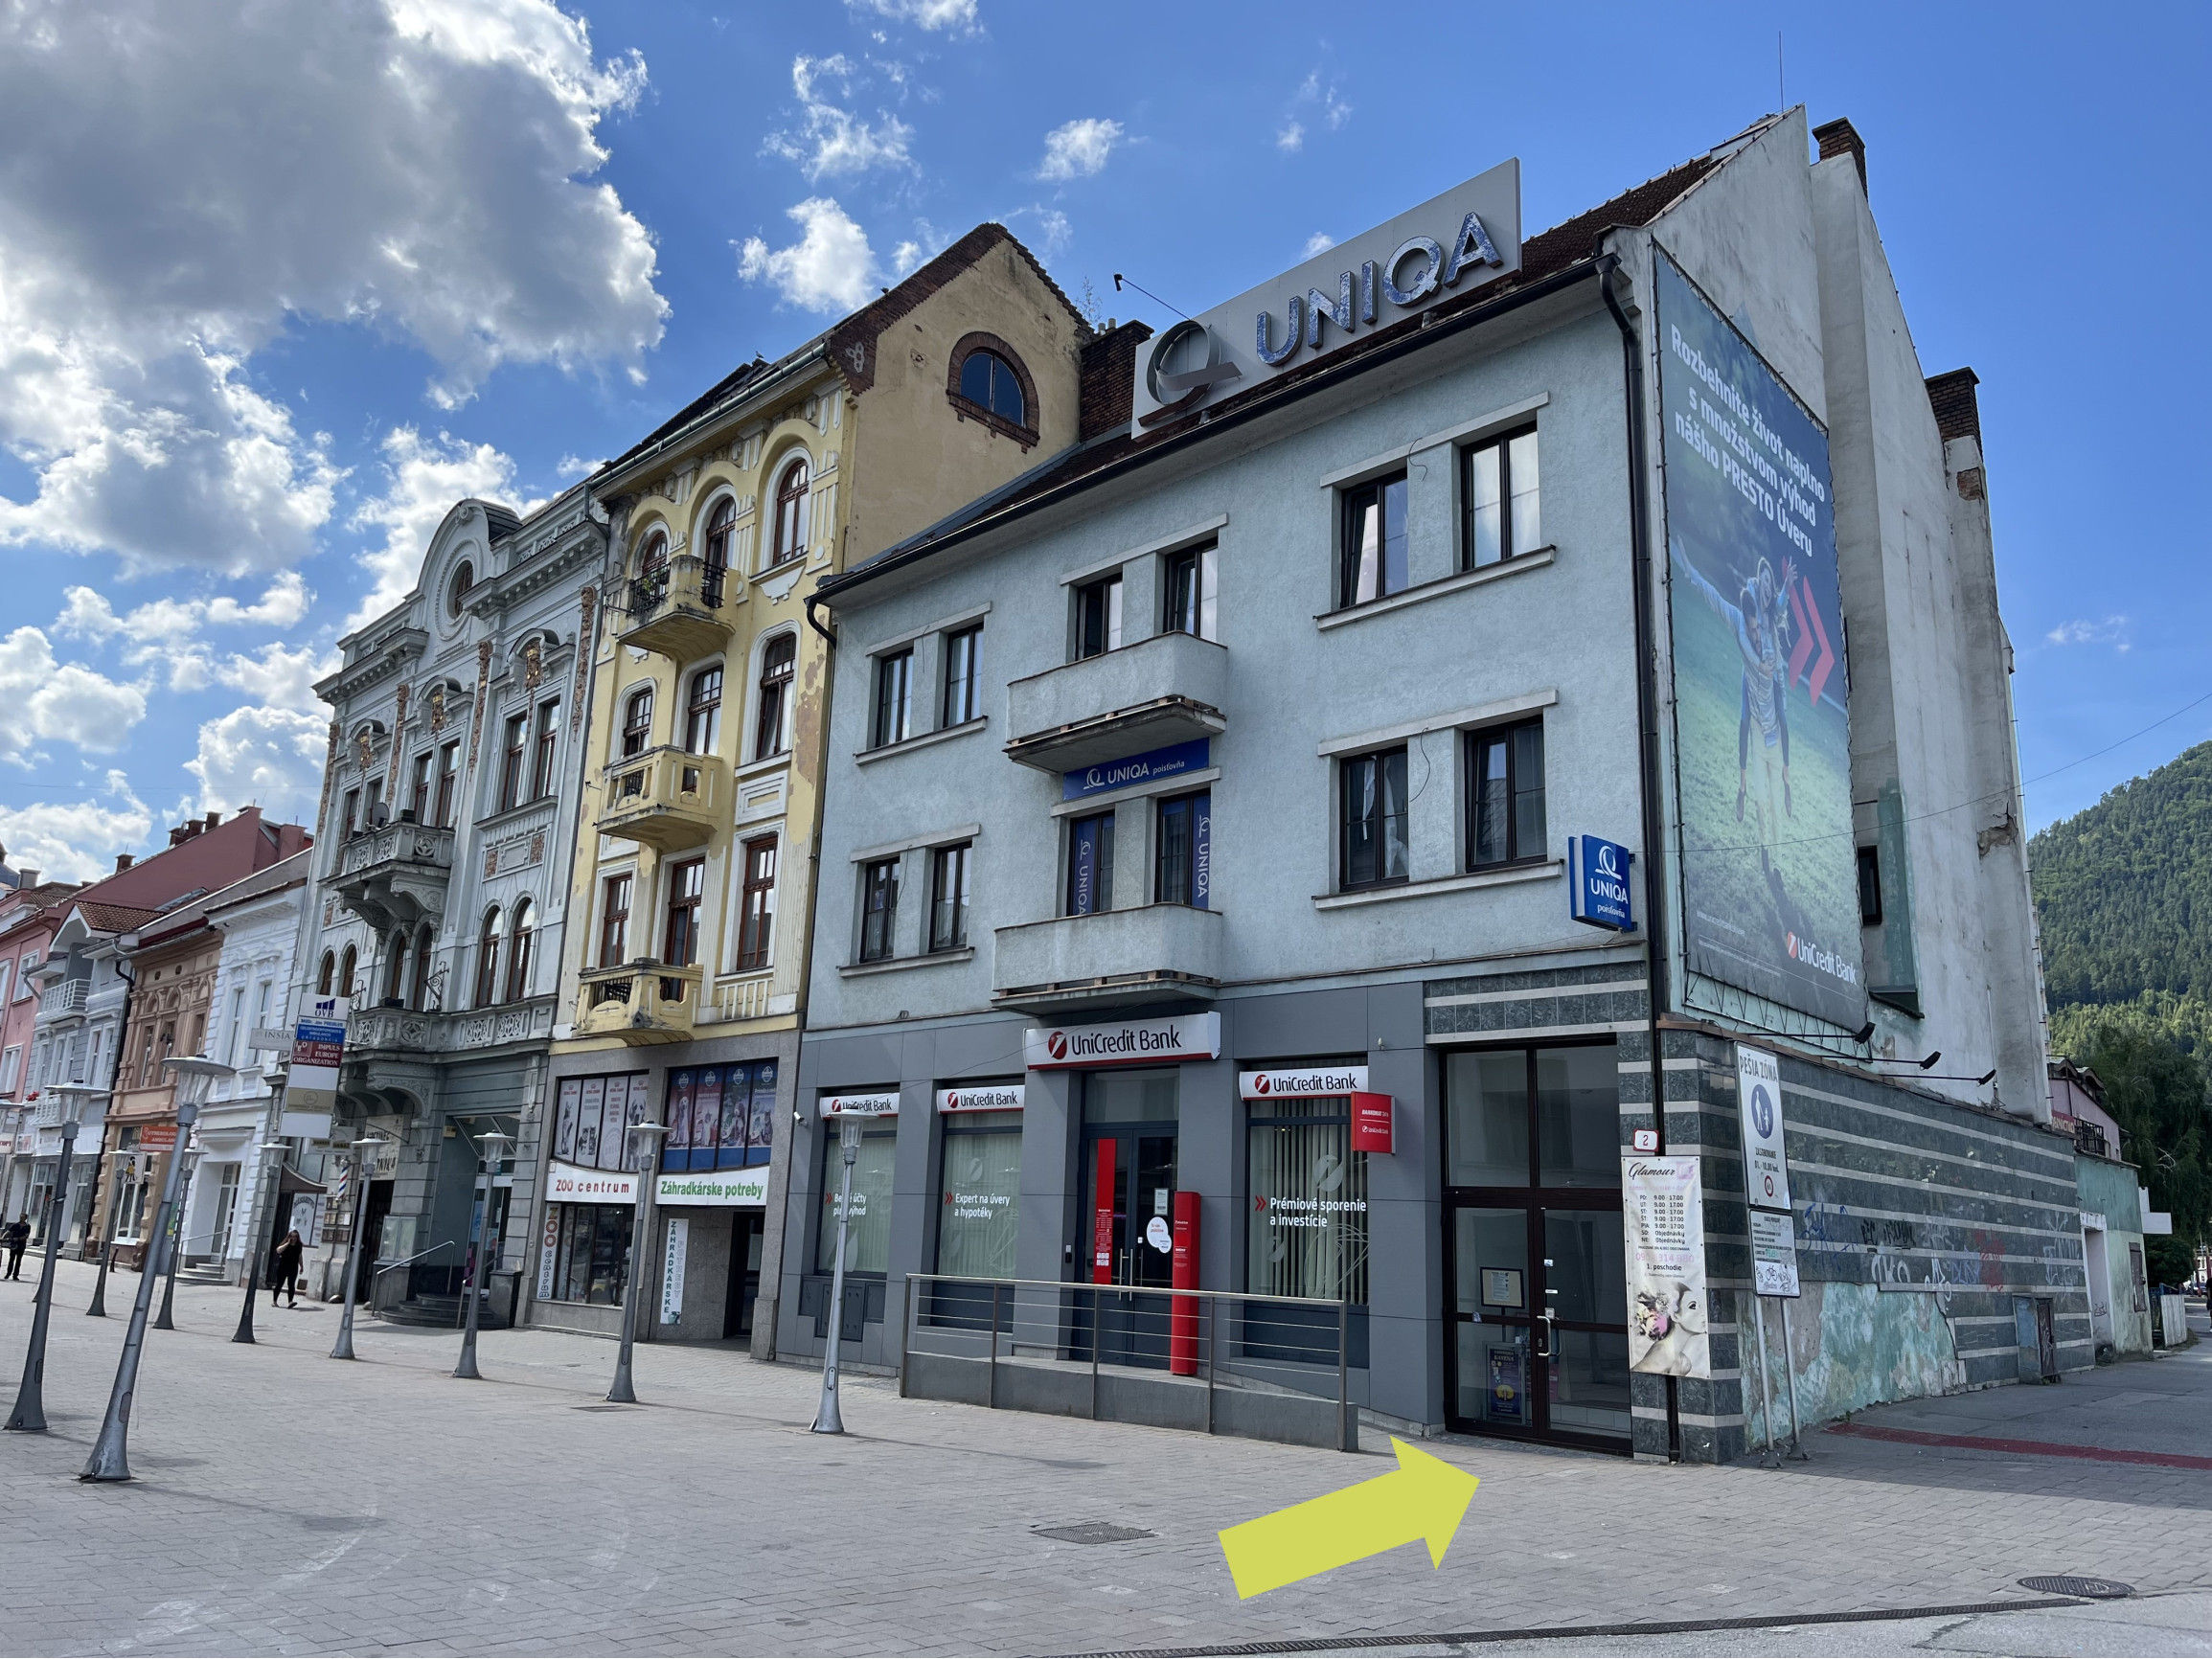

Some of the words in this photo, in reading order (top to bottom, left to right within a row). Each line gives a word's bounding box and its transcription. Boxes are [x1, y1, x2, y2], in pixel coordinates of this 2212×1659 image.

[1256, 212, 1504, 366] UNIQA
[1671, 323, 1750, 424] Rozbehnite
[1752, 406, 1784, 462] život
[1786, 447, 1825, 503] naplno
[1689, 387, 1698, 410] s
[1701, 398, 1778, 490] množstvom
[1780, 477, 1816, 527] výhod
[1676, 411, 1719, 469] nášho
[1722, 450, 1773, 520] PRESTO
[1777, 499, 1813, 557] Úveru
[1107, 762, 1150, 784] UNIQA
[1152, 761, 1185, 777] poisťovňa
[1198, 842, 1209, 898] UNIQA
[1078, 865, 1088, 915] UNIQA
[1590, 877, 1629, 905] UNIQA
[1597, 904, 1626, 919] poisťovňa
[1797, 937, 1836, 976] UniCredit
[1836, 954, 1858, 987] Bank
[314, 1009, 334, 1018] OVB
[1072, 1029, 1137, 1056] UniCredit
[1139, 1025, 1181, 1050] Bank
[293, 1057, 338, 1065] ORGANIZATION
[1740, 1054, 1760, 1077] PEŠIA
[1760, 1059, 1778, 1082] ZÓNA
[1273, 1075, 1323, 1092] UniCredit
[1326, 1073, 1357, 1090] Bank
[874, 1099, 892, 1111] Bank
[960, 1092, 994, 1107] UniCredit
[995, 1091, 1018, 1106] Bank
[1642, 1134, 1649, 1147] 2
[1629, 1162, 1676, 1180] Glamour
[556, 1179, 573, 1192] ZOO
[578, 1180, 629, 1193] centrum
[660, 1180, 722, 1196] Záhradkárske
[725, 1181, 764, 1199] potreby
[853, 1193, 867, 1205] účty
[955, 1193, 978, 1205] Expert
[979, 1195, 989, 1204] na
[990, 1193, 1010, 1207] úvery
[1270, 1196, 1317, 1211] Prémiové
[1320, 1198, 1367, 1214] sporenie
[954, 1209, 959, 1217] a
[960, 1206, 992, 1219] hypotéky
[1270, 1216, 1276, 1226] a
[1279, 1214, 1328, 1228] investície
[544, 1207, 559, 1247] ZOO
